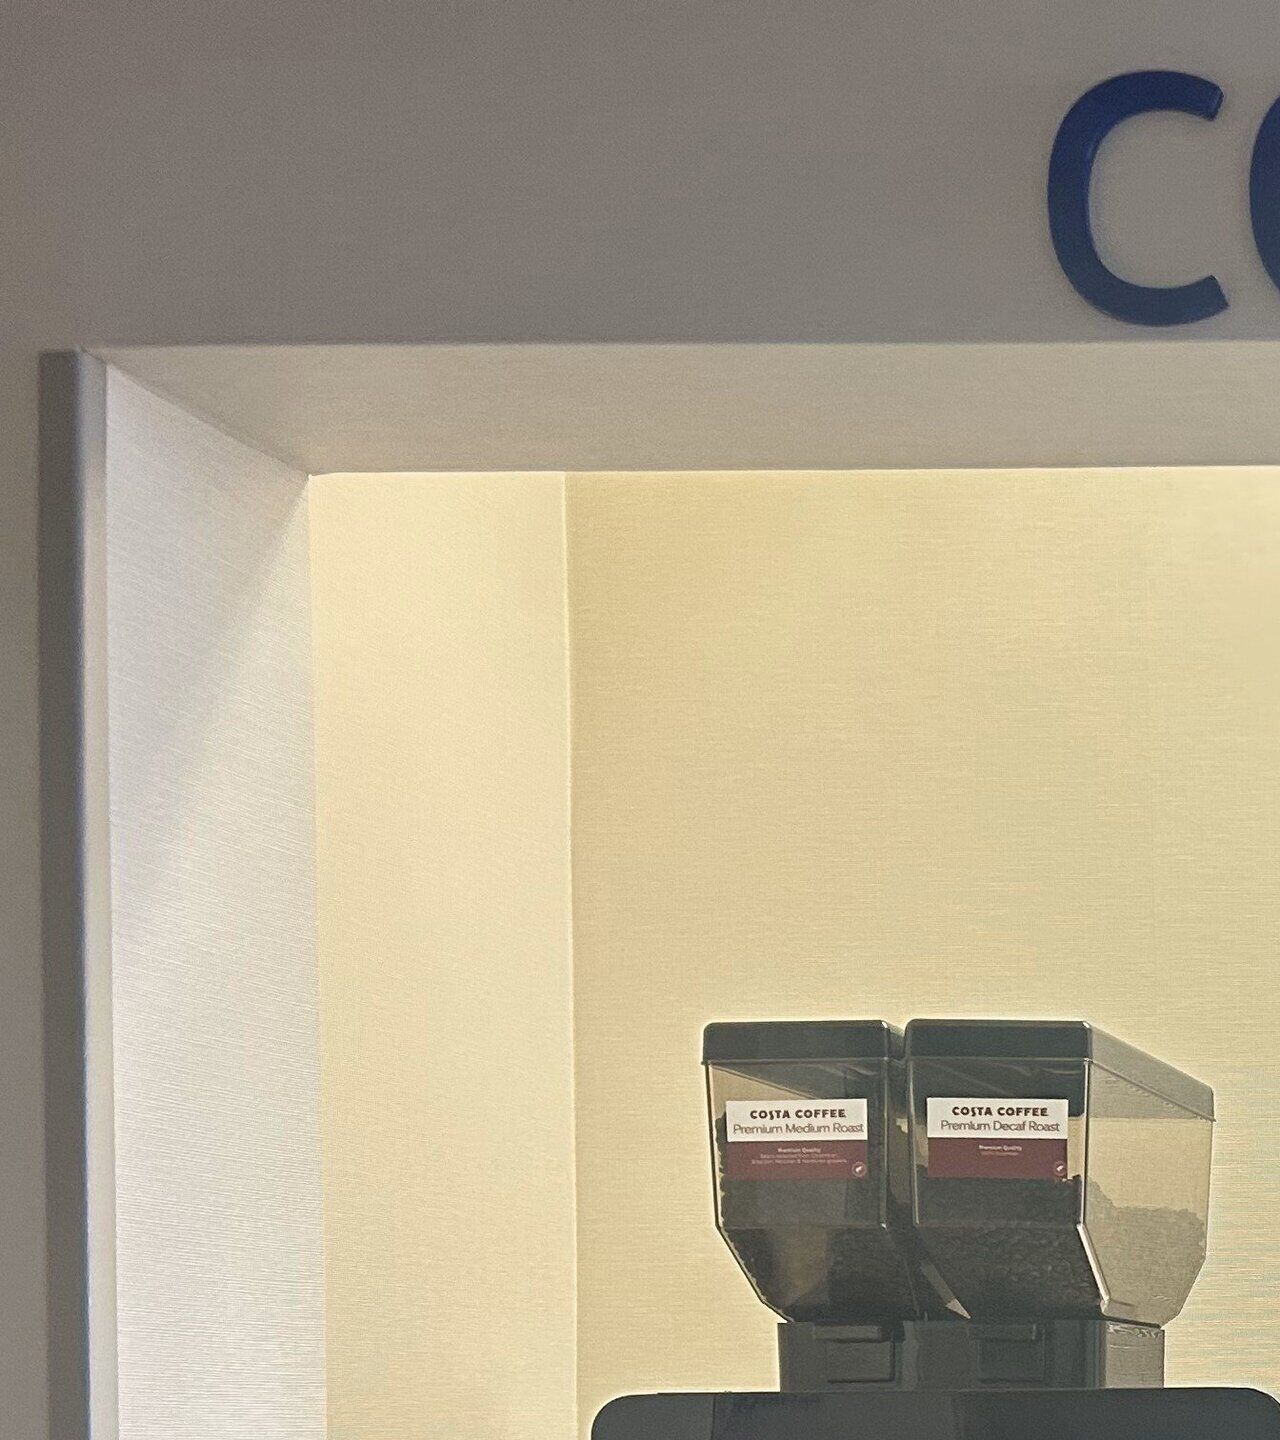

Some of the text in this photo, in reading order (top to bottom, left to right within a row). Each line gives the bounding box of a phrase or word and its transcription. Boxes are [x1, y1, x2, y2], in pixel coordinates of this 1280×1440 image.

[750, 1109, 846, 1120] COSTA COFFEE
[952, 1106, 1049, 1117] COSTA COFFEE
[733, 1122, 864, 1135] Premium Medium Roast
[940, 1120, 1060, 1132] Premium Decaf Roast
